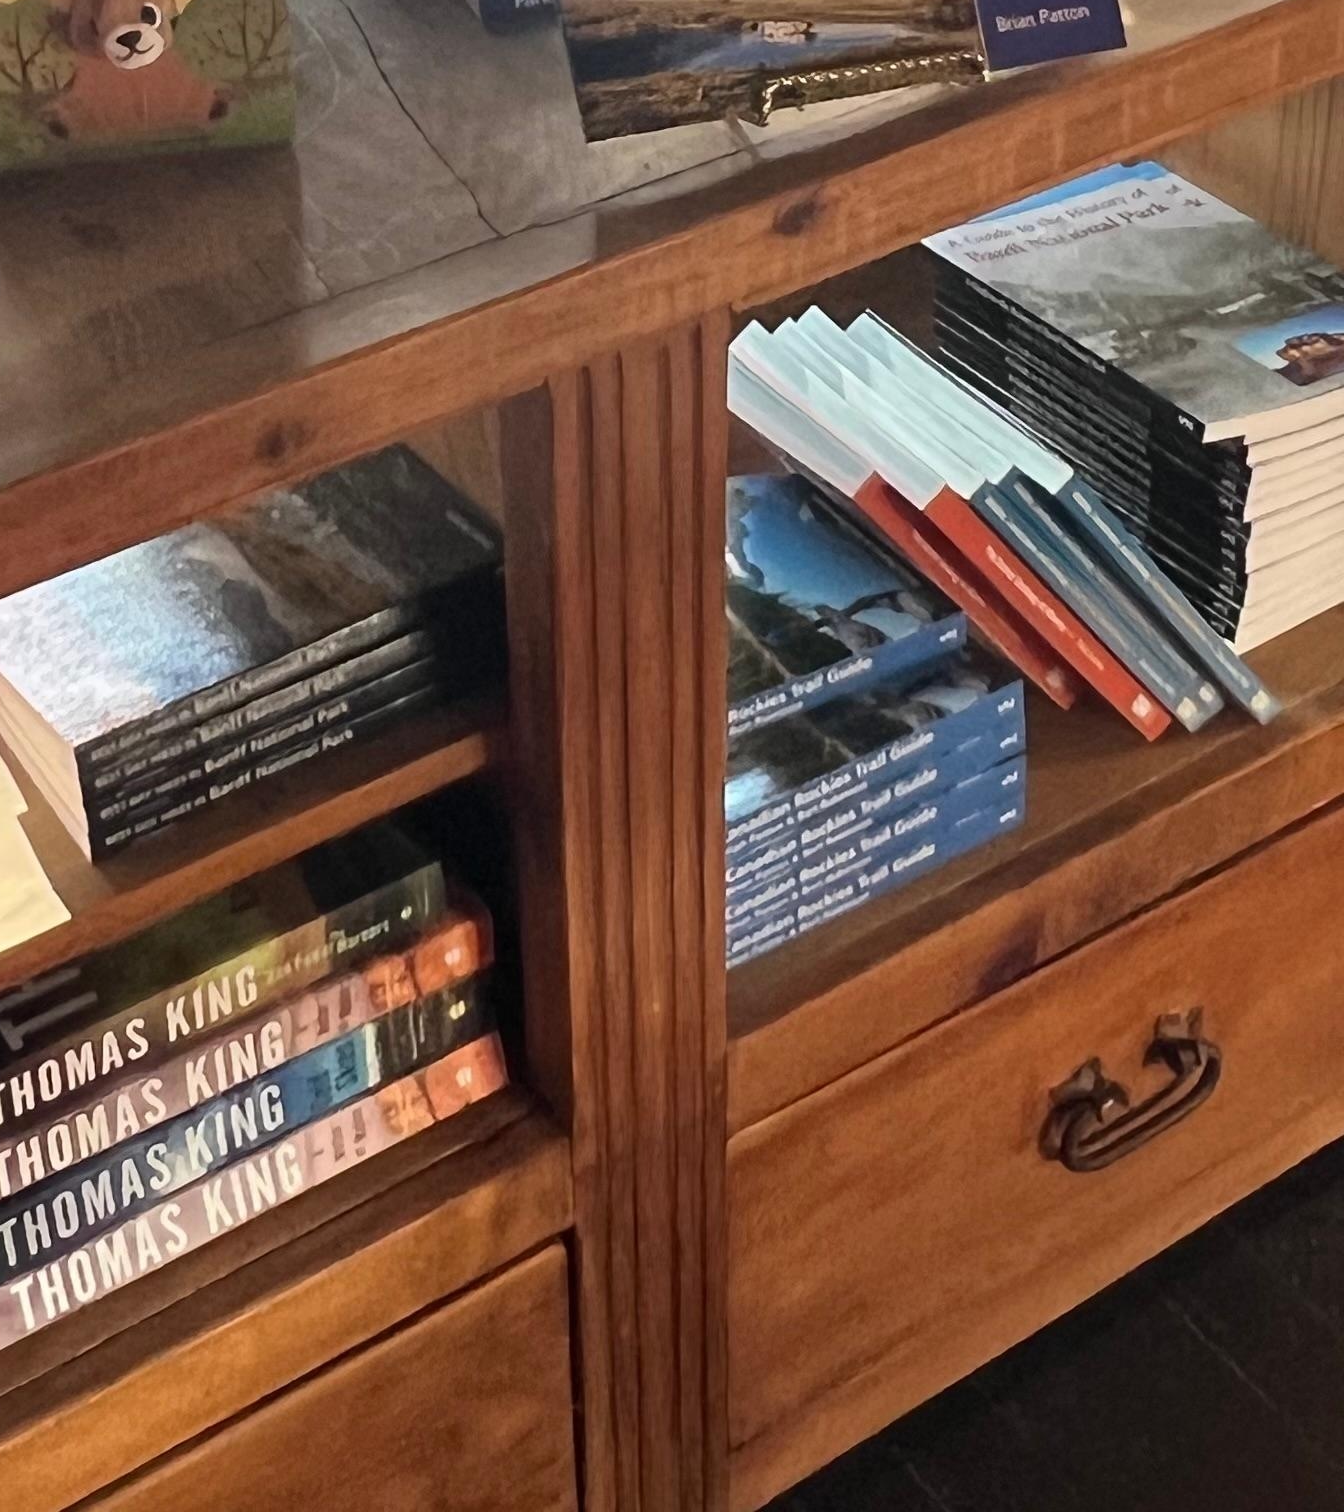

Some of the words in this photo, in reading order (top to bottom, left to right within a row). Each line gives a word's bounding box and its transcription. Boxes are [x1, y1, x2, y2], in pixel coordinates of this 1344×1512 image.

[995, 13, 1037, 33] Brian
[166, 964, 258, 1042] KING
[185, 1019, 287, 1105] KING
[184, 1083, 285, 1172] KING
[9, 1202, 189, 1331] THOMAS
[201, 1144, 304, 1234] KING
